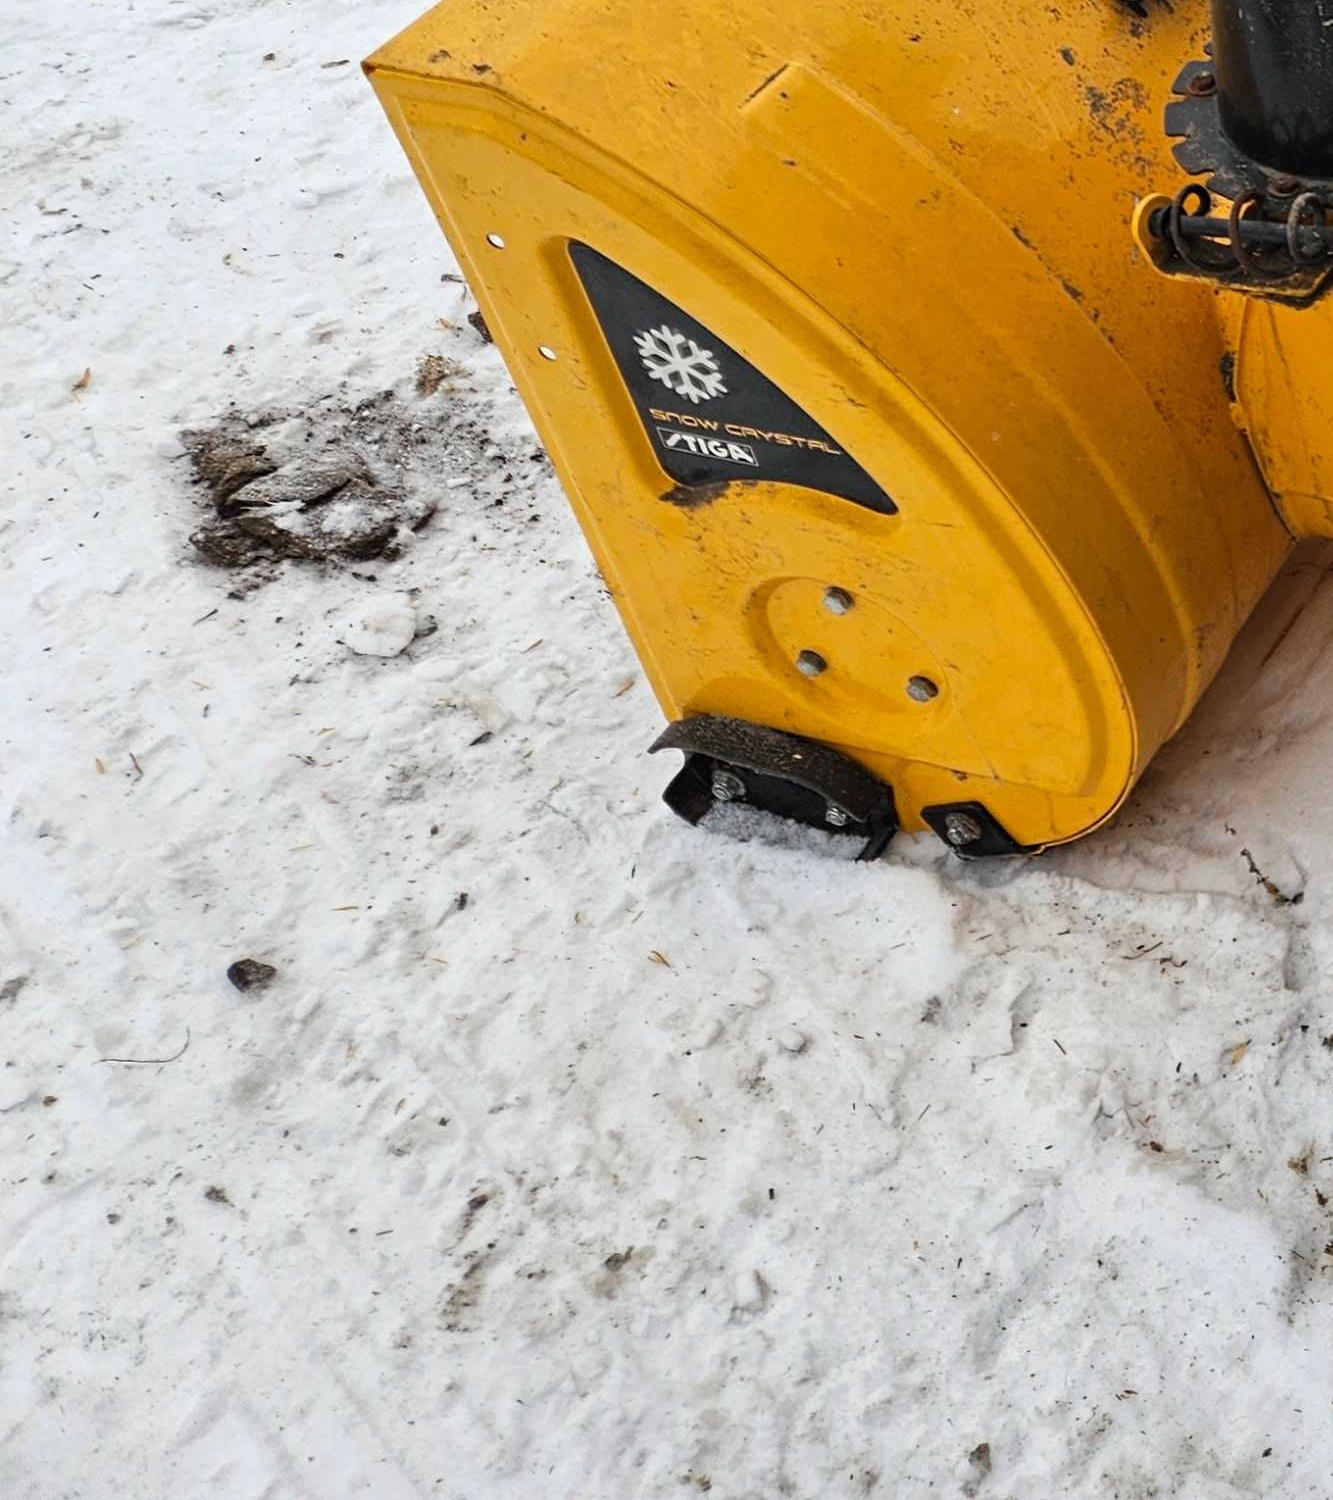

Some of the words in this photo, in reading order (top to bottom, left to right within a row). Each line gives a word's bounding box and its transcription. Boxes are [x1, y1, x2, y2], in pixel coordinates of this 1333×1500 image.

[649, 408, 719, 432] SNOW
[724, 423, 843, 456] CRYSTAL
[665, 432, 755, 464] STIGA
